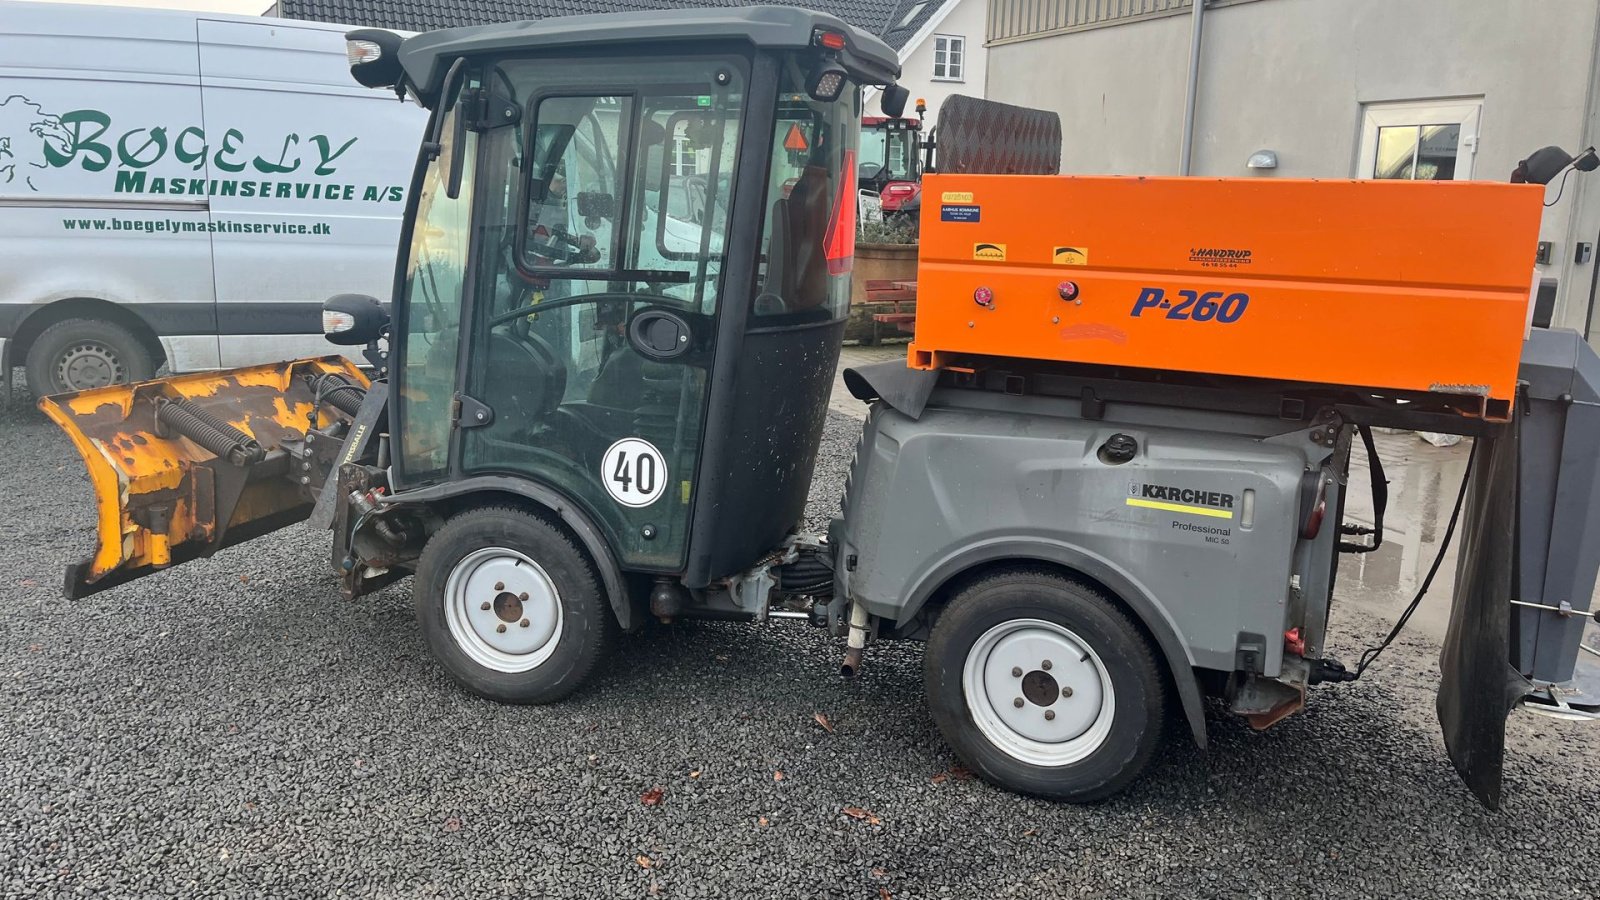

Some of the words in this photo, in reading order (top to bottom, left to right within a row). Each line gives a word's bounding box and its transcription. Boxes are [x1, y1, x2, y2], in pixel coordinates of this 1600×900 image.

[44, 109, 359, 176] BØGELY
[114, 170, 355, 201] MASKINSERVICE
[363, 186, 404, 203] A/S
[63, 217, 332, 236] www.boegelymaskinservice.dk
[1197, 248, 1252, 258] HAVDRUP
[1130, 287, 1250, 323] P-260
[613, 450, 655, 495] 40
[1142, 484, 1234, 508] KÄRCHER
[1172, 520, 1231, 537] Professional
[1205, 536, 1219, 544] MIC
